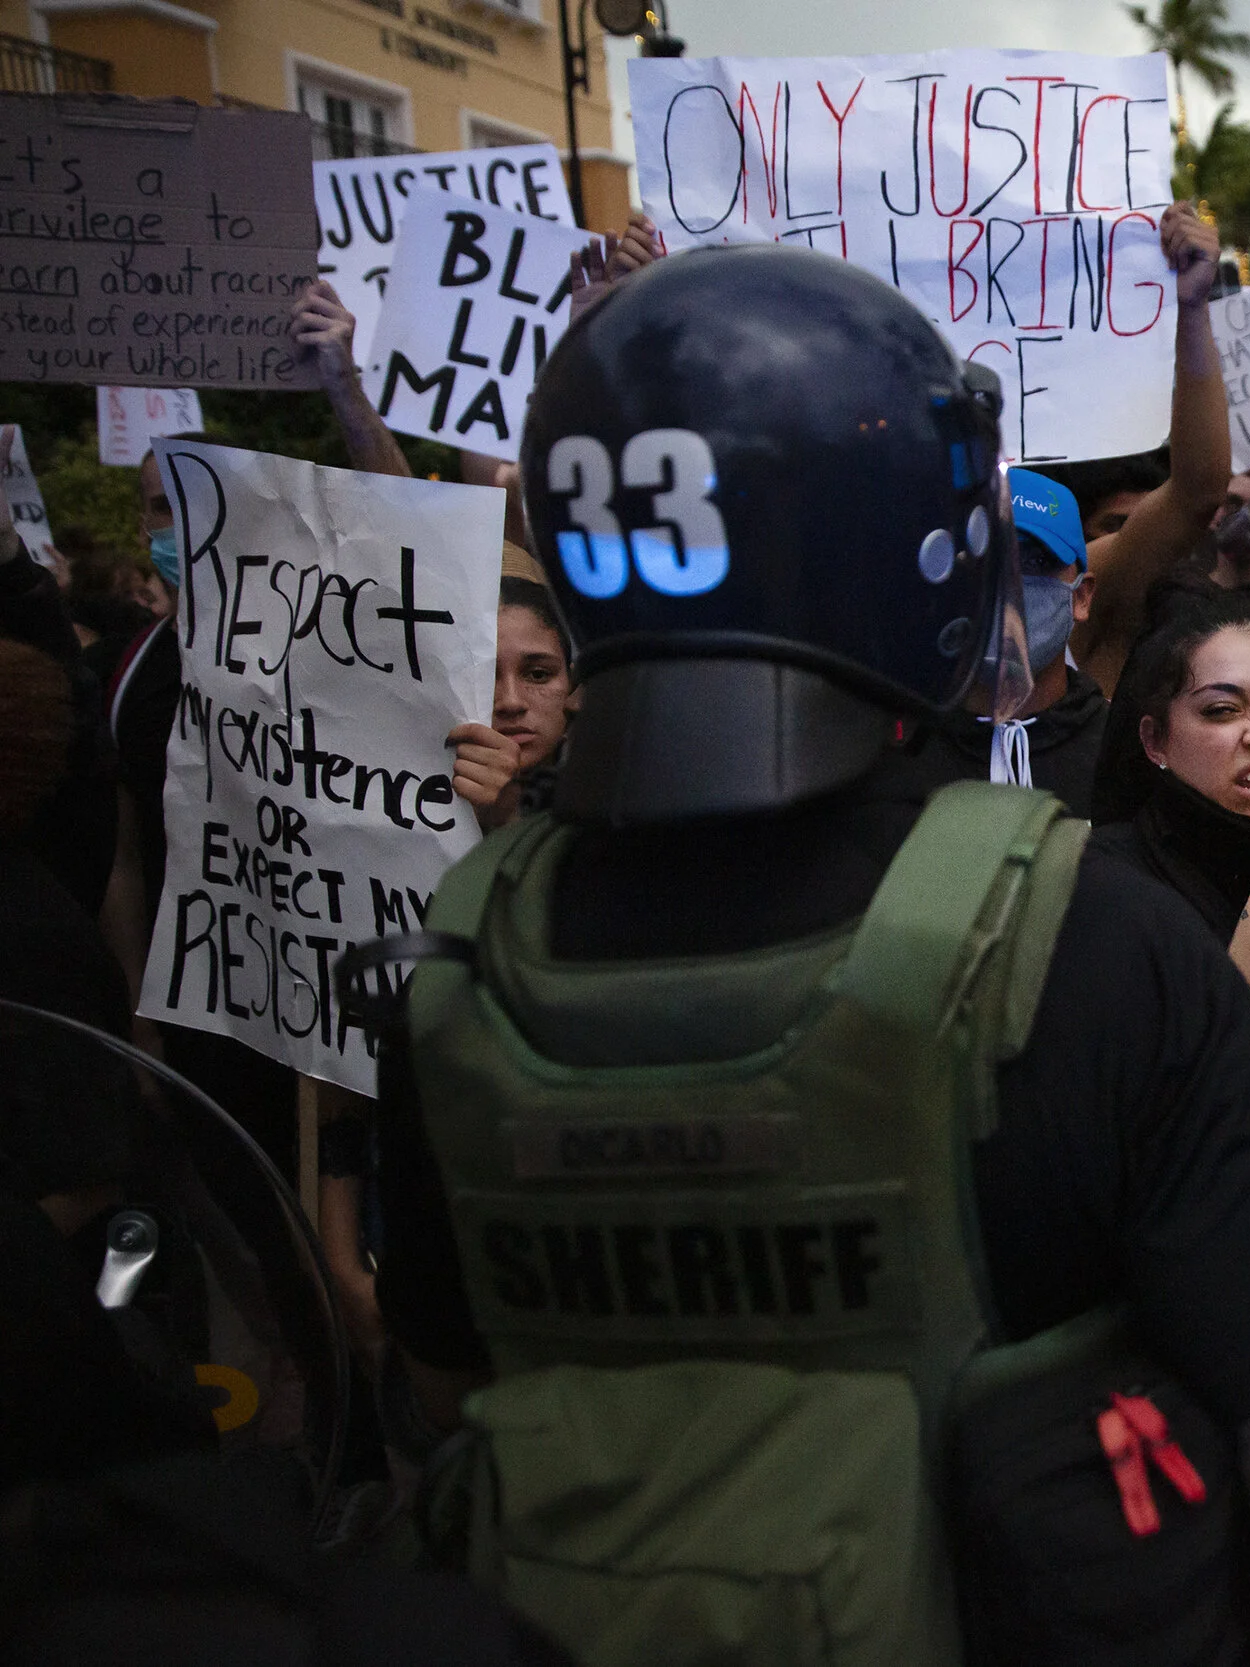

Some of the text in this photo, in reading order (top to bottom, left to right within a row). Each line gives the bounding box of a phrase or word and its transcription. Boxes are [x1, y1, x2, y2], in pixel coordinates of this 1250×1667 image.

[136, 168, 164, 198] a
[663, 73, 1171, 233] ONLY JUSTICE
[0, 193, 254, 267] rivilege to
[0, 264, 78, 297] arn
[100, 250, 203, 294] about
[948, 213, 1165, 336] BRING
[87, 303, 125, 335] of
[27, 349, 112, 380] your
[237, 346, 297, 382] life
[548, 427, 730, 598] 33
[217, 706, 456, 832] existence
[256, 795, 313, 857] OR
[202, 821, 346, 924] EXPECT
[482, 1216, 883, 1318] SHERIFF
